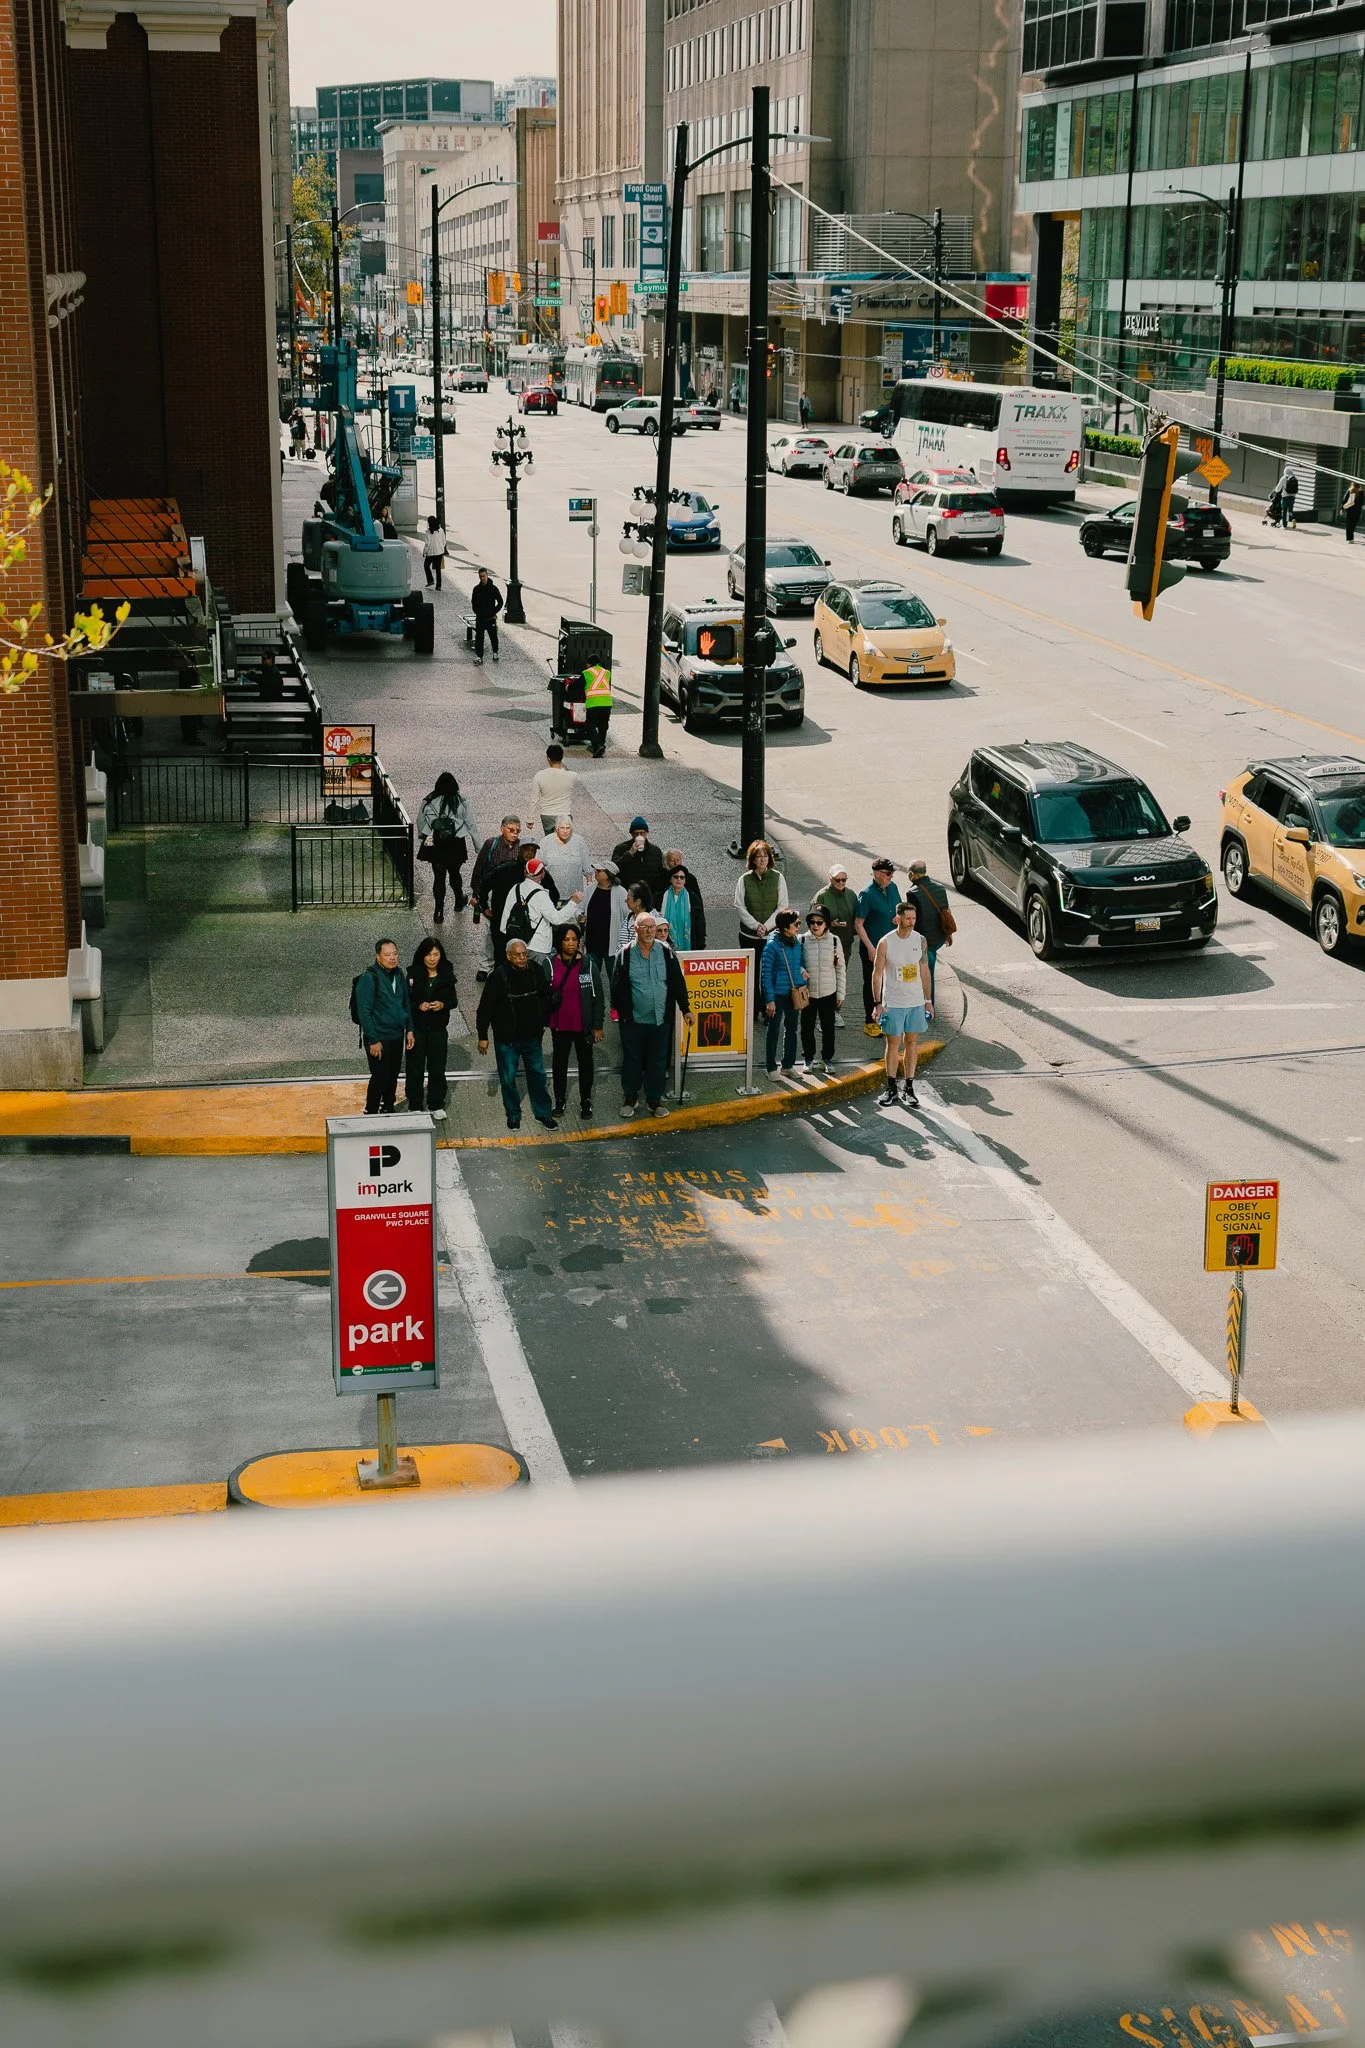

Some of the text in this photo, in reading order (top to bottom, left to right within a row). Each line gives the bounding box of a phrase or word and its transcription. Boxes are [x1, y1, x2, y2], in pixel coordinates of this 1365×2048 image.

[627, 184, 663, 193] Food Court
[635, 193, 663, 201] & Shops
[1002, 306, 1026, 318] SFU
[1124, 315, 1160, 331] DEVILLE
[1013, 404, 1071, 422] TRAXX
[327, 735, 352, 752] $4.99
[689, 960, 740, 972] DANGER
[699, 978, 729, 989] OBEY
[687, 988, 743, 999] CROSSING
[693, 1000, 734, 1010] SIGNAL
[357, 1180, 413, 1197] impark
[1213, 1185, 1274, 1199] DANGER
[1228, 1202, 1258, 1212] OBEY
[354, 1210, 429, 1221] GRANVILLE SQUARE
[1215, 1211, 1271, 1222] CROSSING
[405, 1218, 429, 1226] PLACE
[1223, 1222, 1263, 1231] SIGNAL
[348, 1315, 425, 1352] park
[816, 1424, 943, 1453] LOOK
